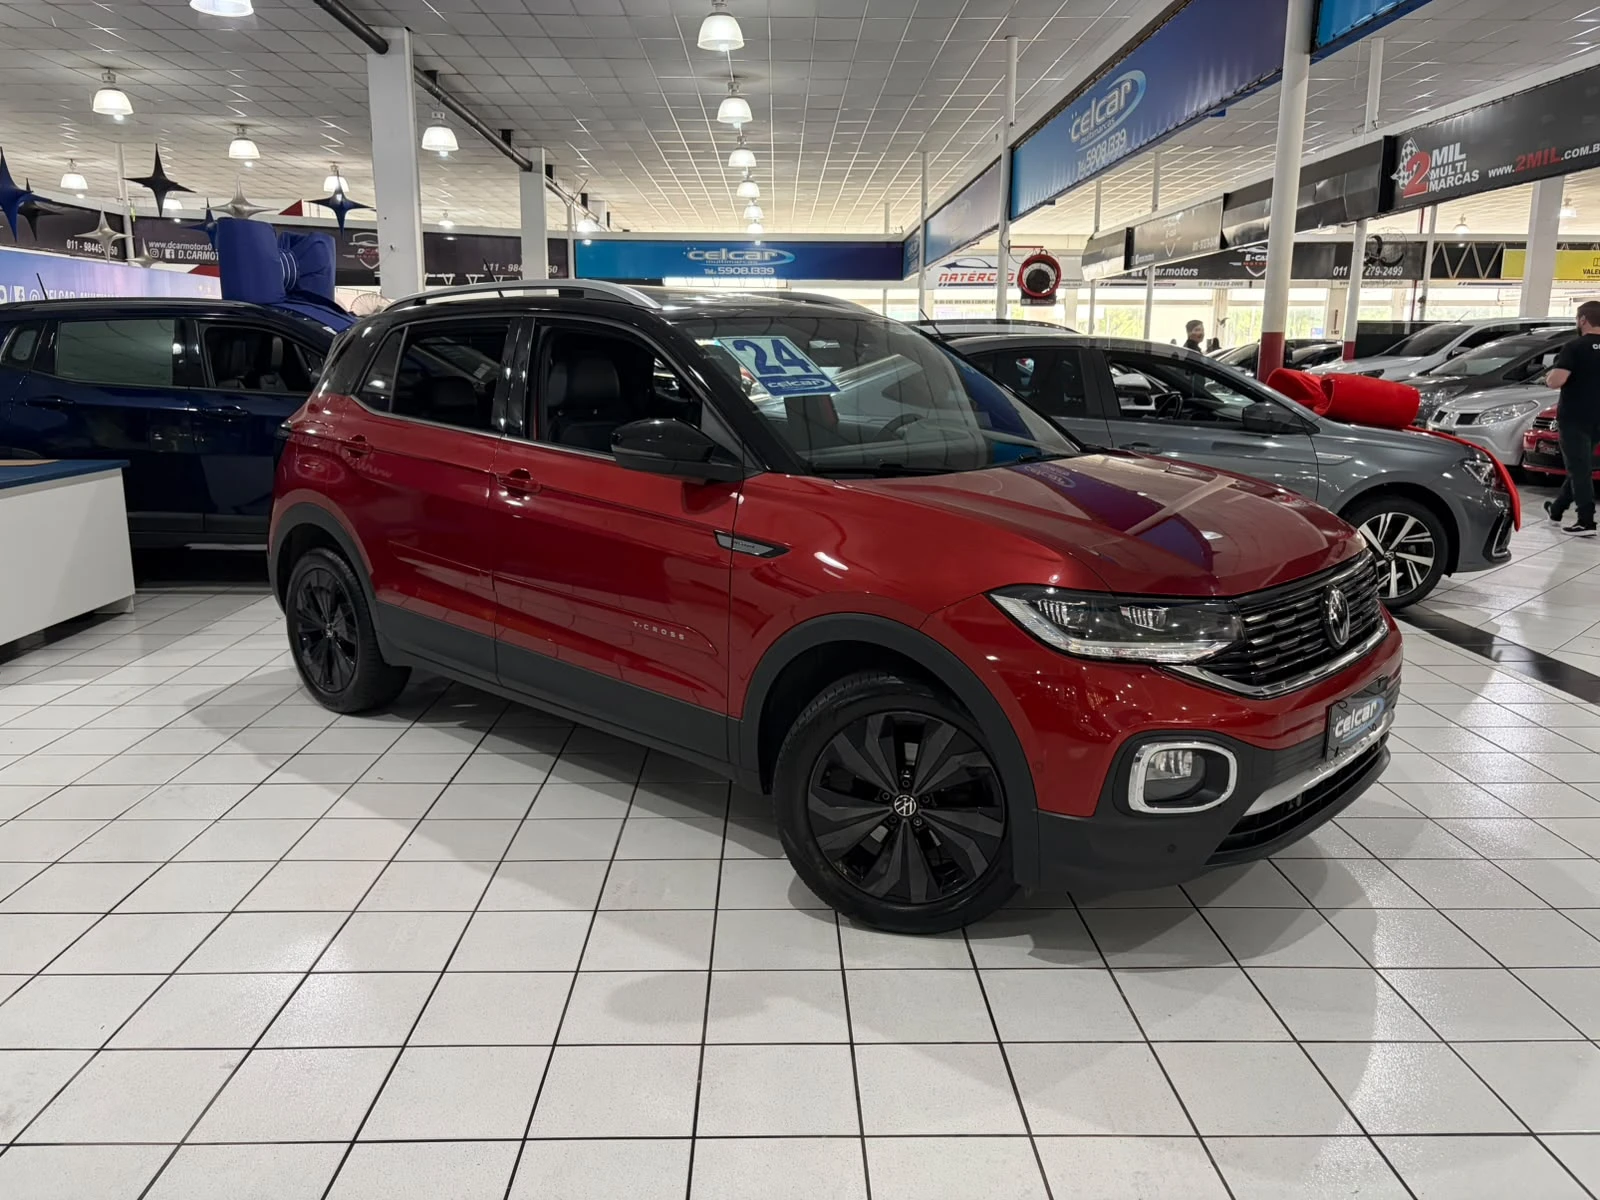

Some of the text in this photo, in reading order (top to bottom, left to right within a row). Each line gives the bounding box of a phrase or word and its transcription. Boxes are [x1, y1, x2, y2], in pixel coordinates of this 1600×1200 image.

[1070, 80, 1132, 143] celcar
[1402, 142, 1467, 199] 2 MIL
[1428, 169, 1480, 193] MARCAS
[1430, 160, 1468, 180] MULTI
[178, 248, 220, 261] D.CARMOT
[687, 247, 778, 261] celcar
[1333, 265, 1348, 276] 011
[731, 339, 813, 375] 24
[1334, 699, 1378, 738] celcar
